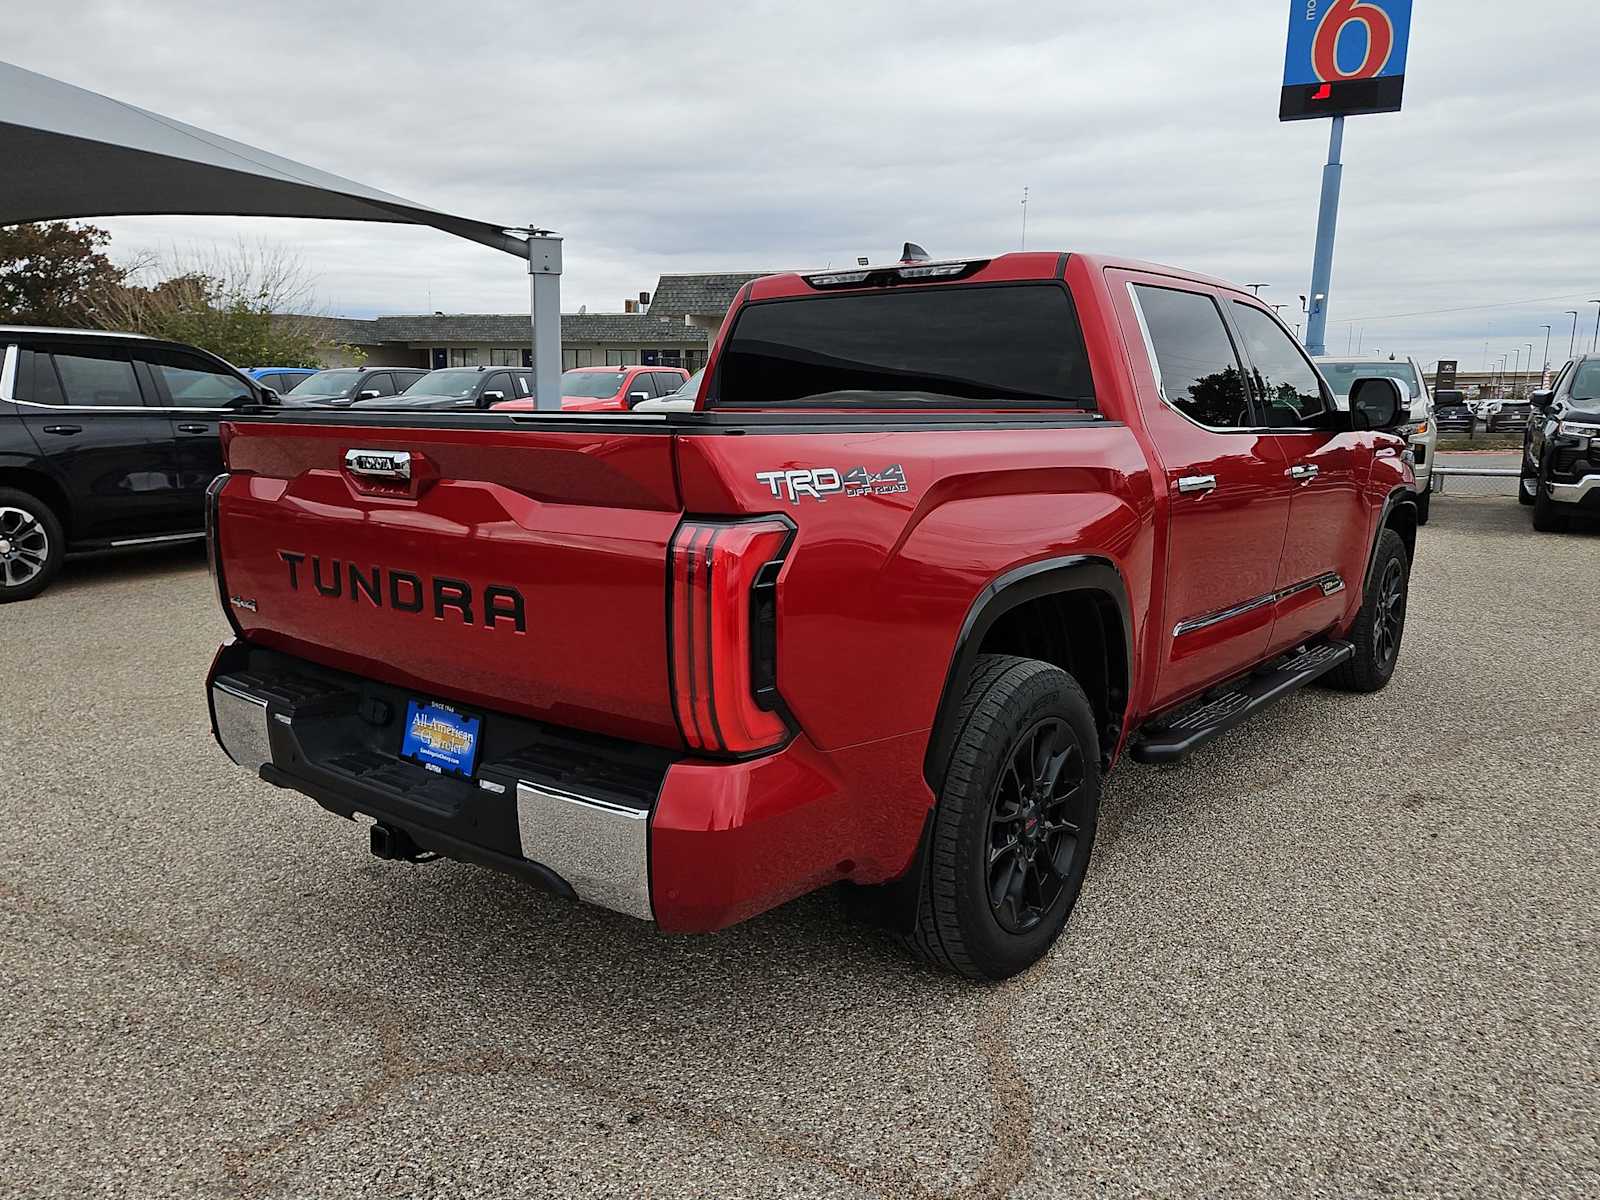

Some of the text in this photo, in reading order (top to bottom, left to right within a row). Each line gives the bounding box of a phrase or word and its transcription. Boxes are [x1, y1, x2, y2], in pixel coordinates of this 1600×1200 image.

[1311, 0, 1394, 82] 6
[361, 456, 392, 470] TOYOTA
[755, 463, 907, 504] TRD 4x4
[847, 484, 909, 497] OFF ROAD
[276, 549, 527, 635] TUNDRA
